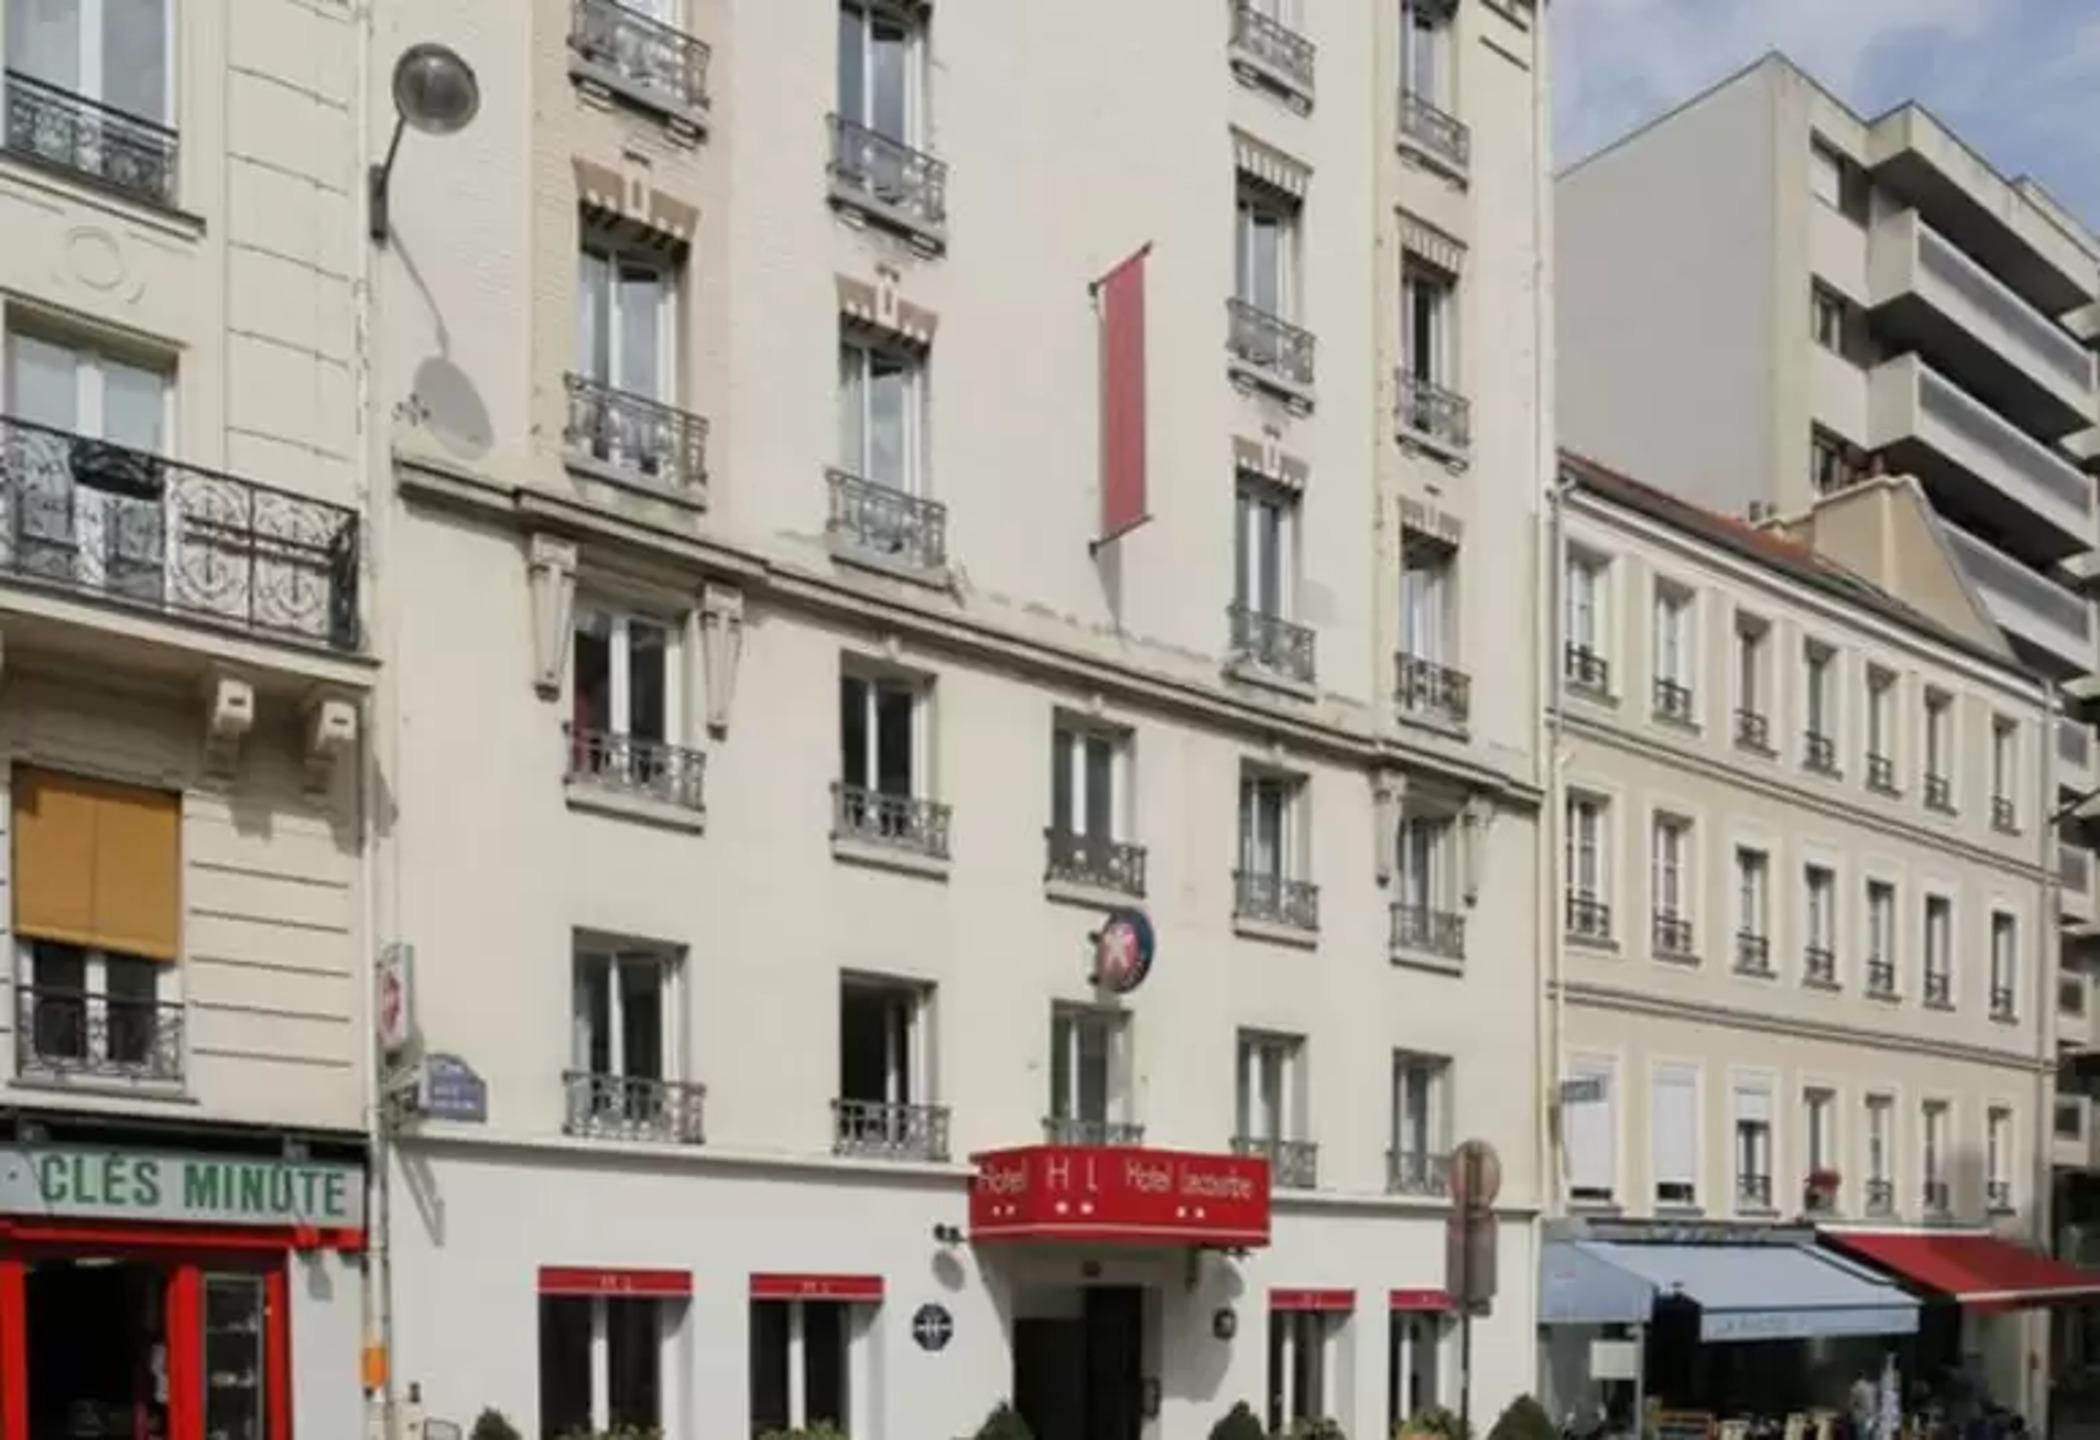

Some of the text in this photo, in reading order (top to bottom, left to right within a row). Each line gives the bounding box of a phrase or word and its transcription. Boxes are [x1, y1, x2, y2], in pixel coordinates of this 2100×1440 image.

[39, 1151, 347, 1216] CLÉS MINUTE
[1046, 1154, 1069, 1191] H
